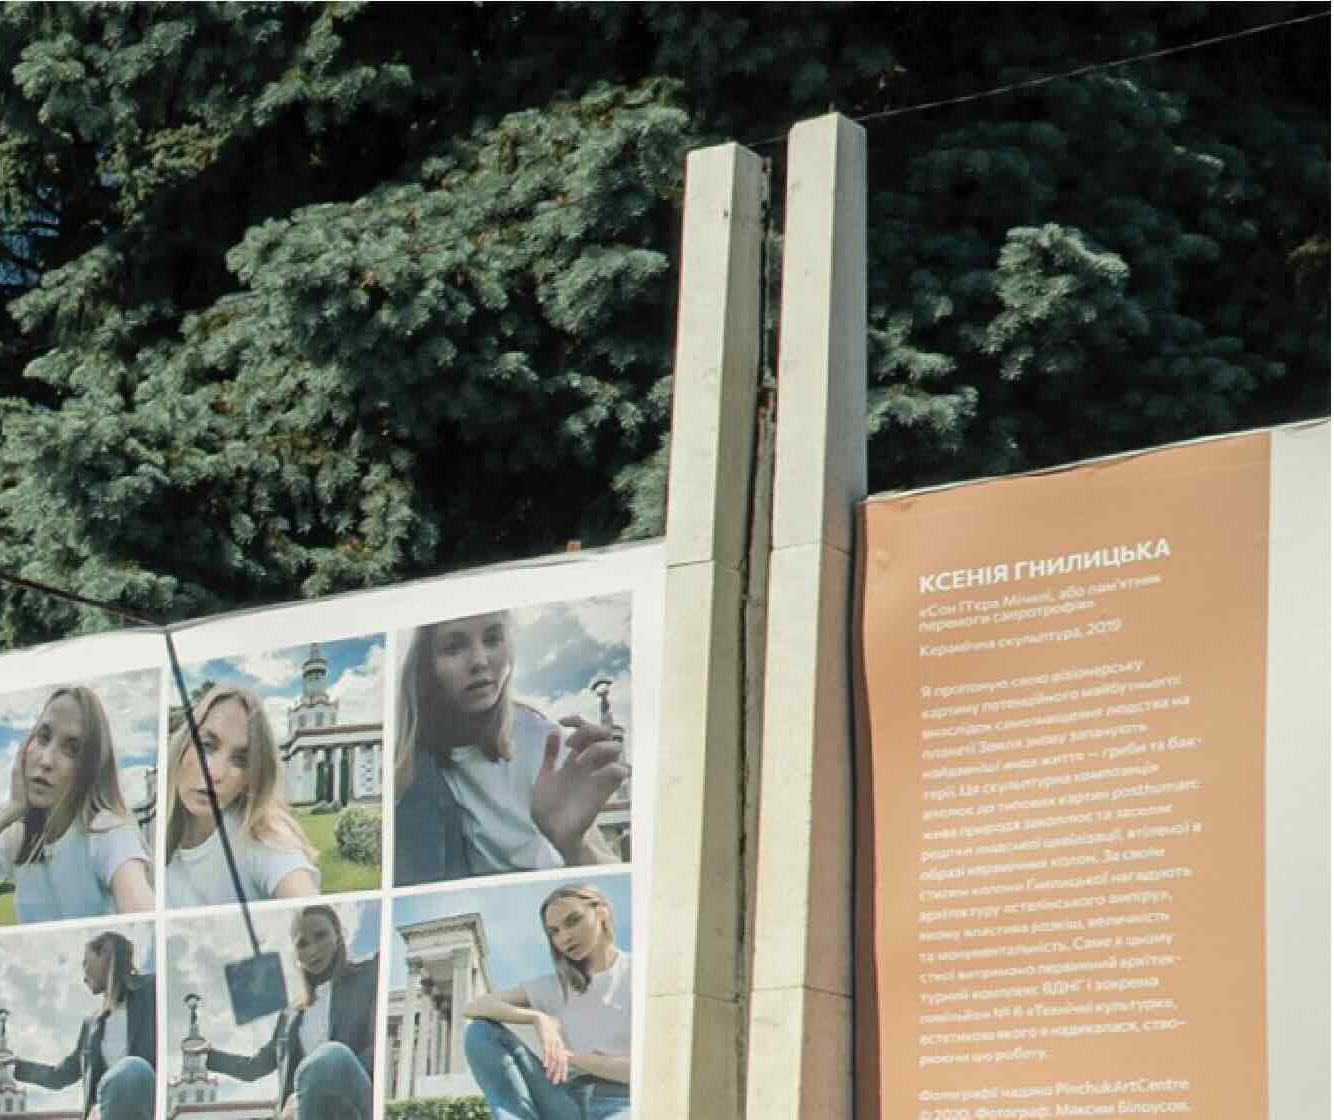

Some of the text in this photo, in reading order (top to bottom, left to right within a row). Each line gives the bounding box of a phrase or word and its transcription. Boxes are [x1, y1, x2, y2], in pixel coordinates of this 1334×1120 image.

[920, 539, 1171, 592] КСЕНІЯ ГНИЛИЦЬКА
[1056, 1079, 1189, 1095] PinchukArtCentre
